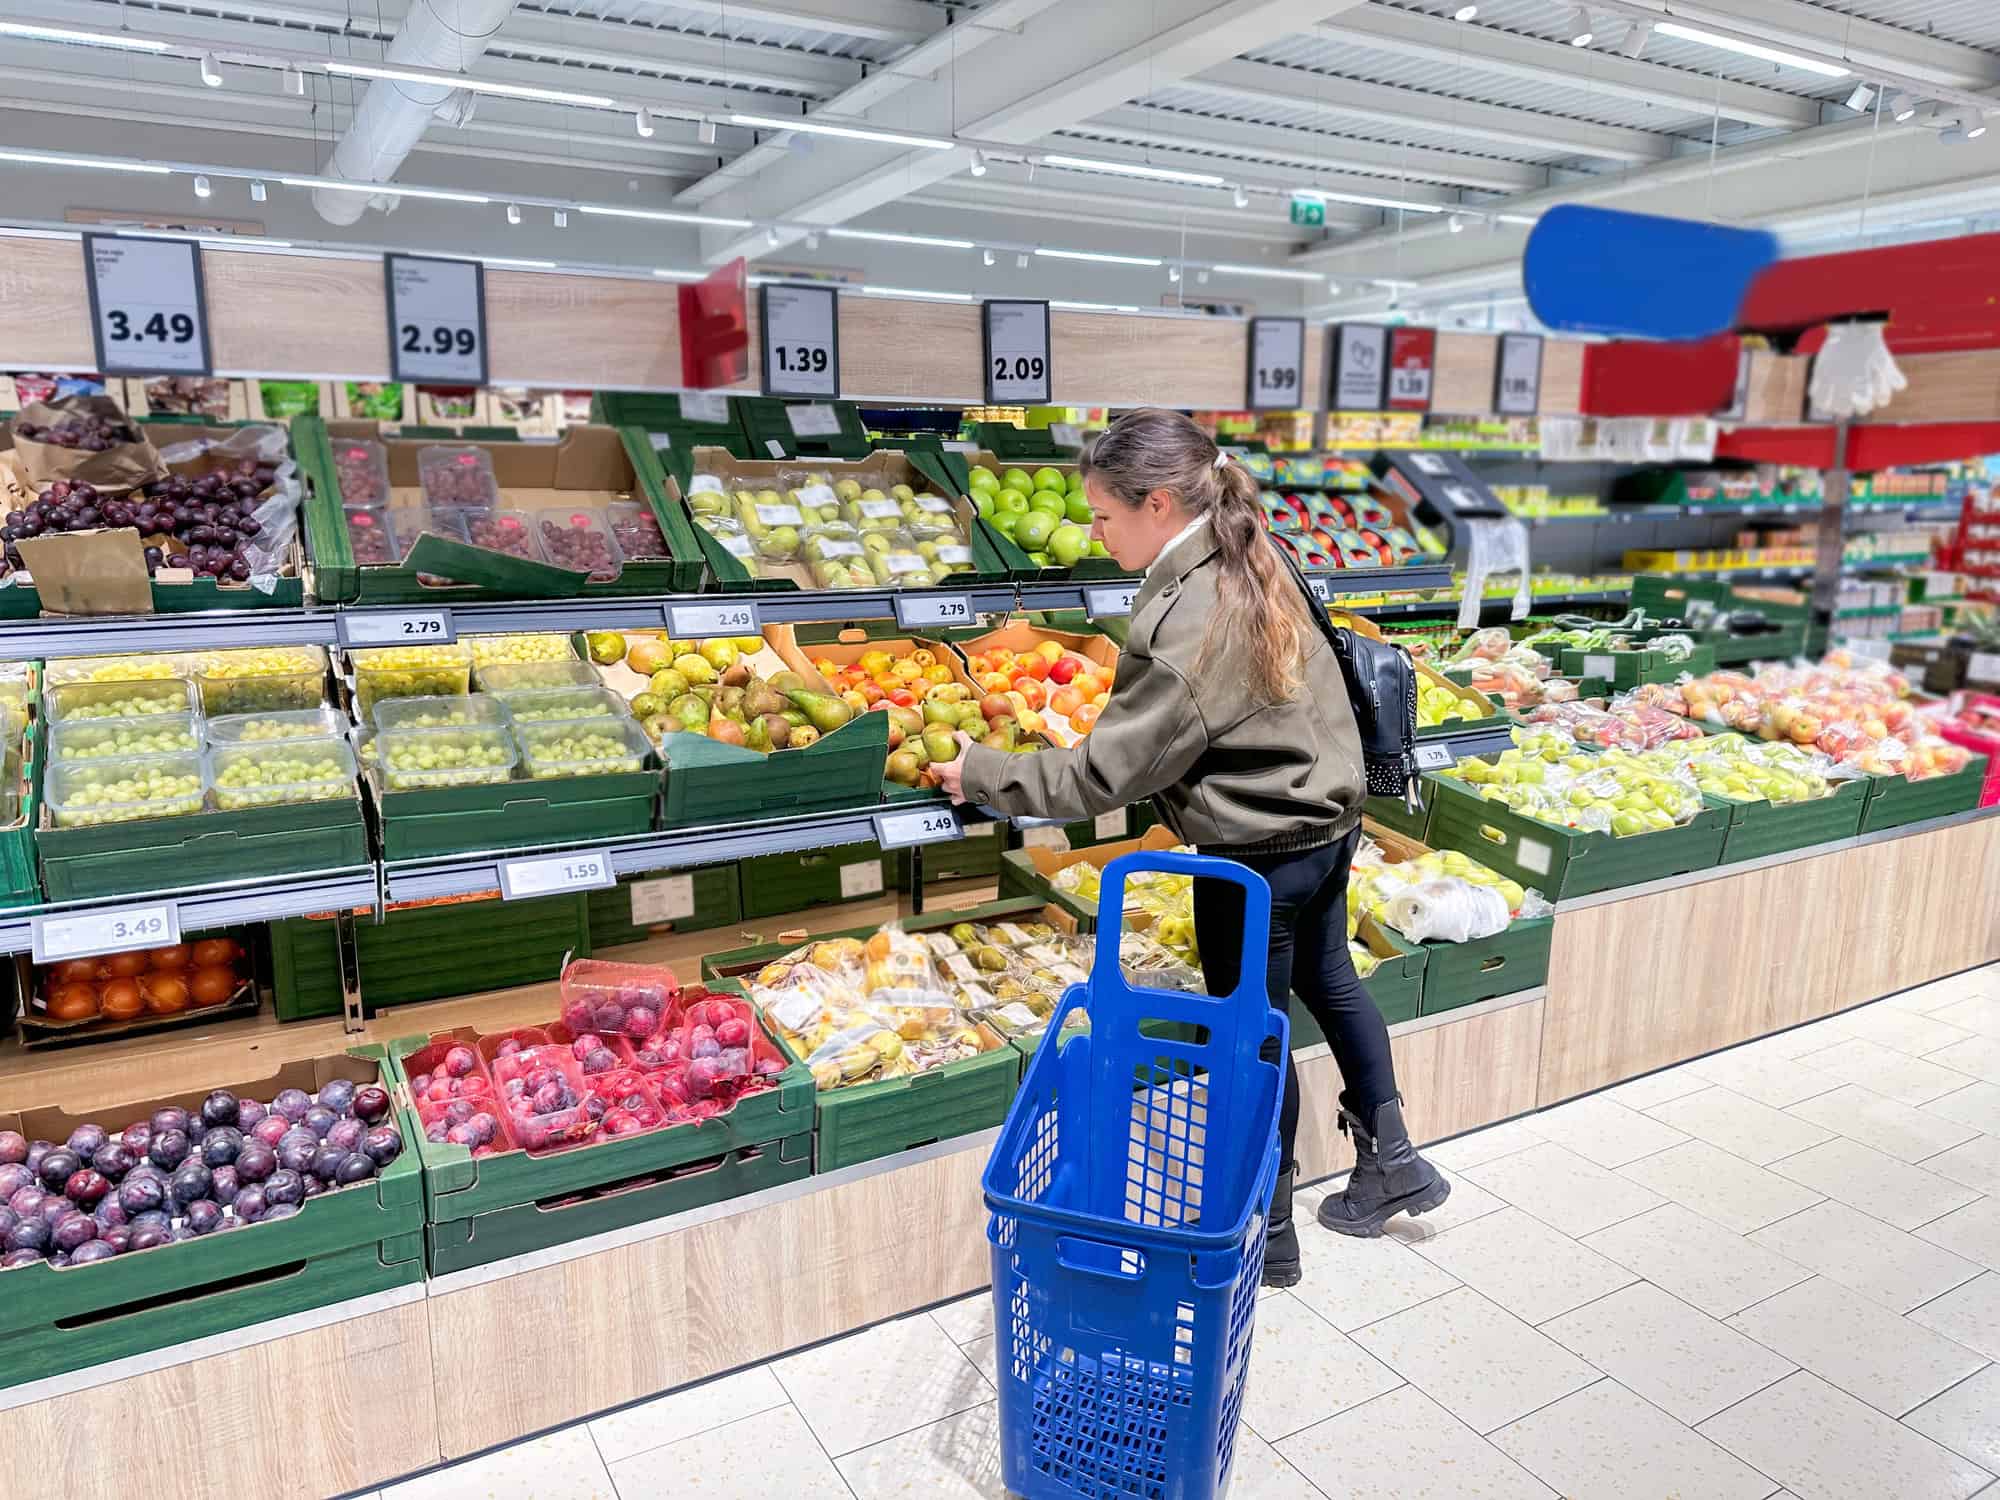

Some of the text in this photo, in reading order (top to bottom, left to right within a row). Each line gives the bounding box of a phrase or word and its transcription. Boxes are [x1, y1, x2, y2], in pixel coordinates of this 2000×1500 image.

[107, 310, 194, 343] 3.49
[402, 325, 475, 355] 2.99
[776, 346, 827, 372] 1.39
[995, 357, 1044, 380] 2.09
[1259, 368, 1296, 390] 1.99
[719, 612, 749, 625] 2.49
[939, 603, 965, 616] 2.79
[403, 620, 441, 634] 2.79
[923, 817, 951, 832] 2.49
[564, 863, 599, 879] 1.59
[114, 918, 162, 938] 3.49
